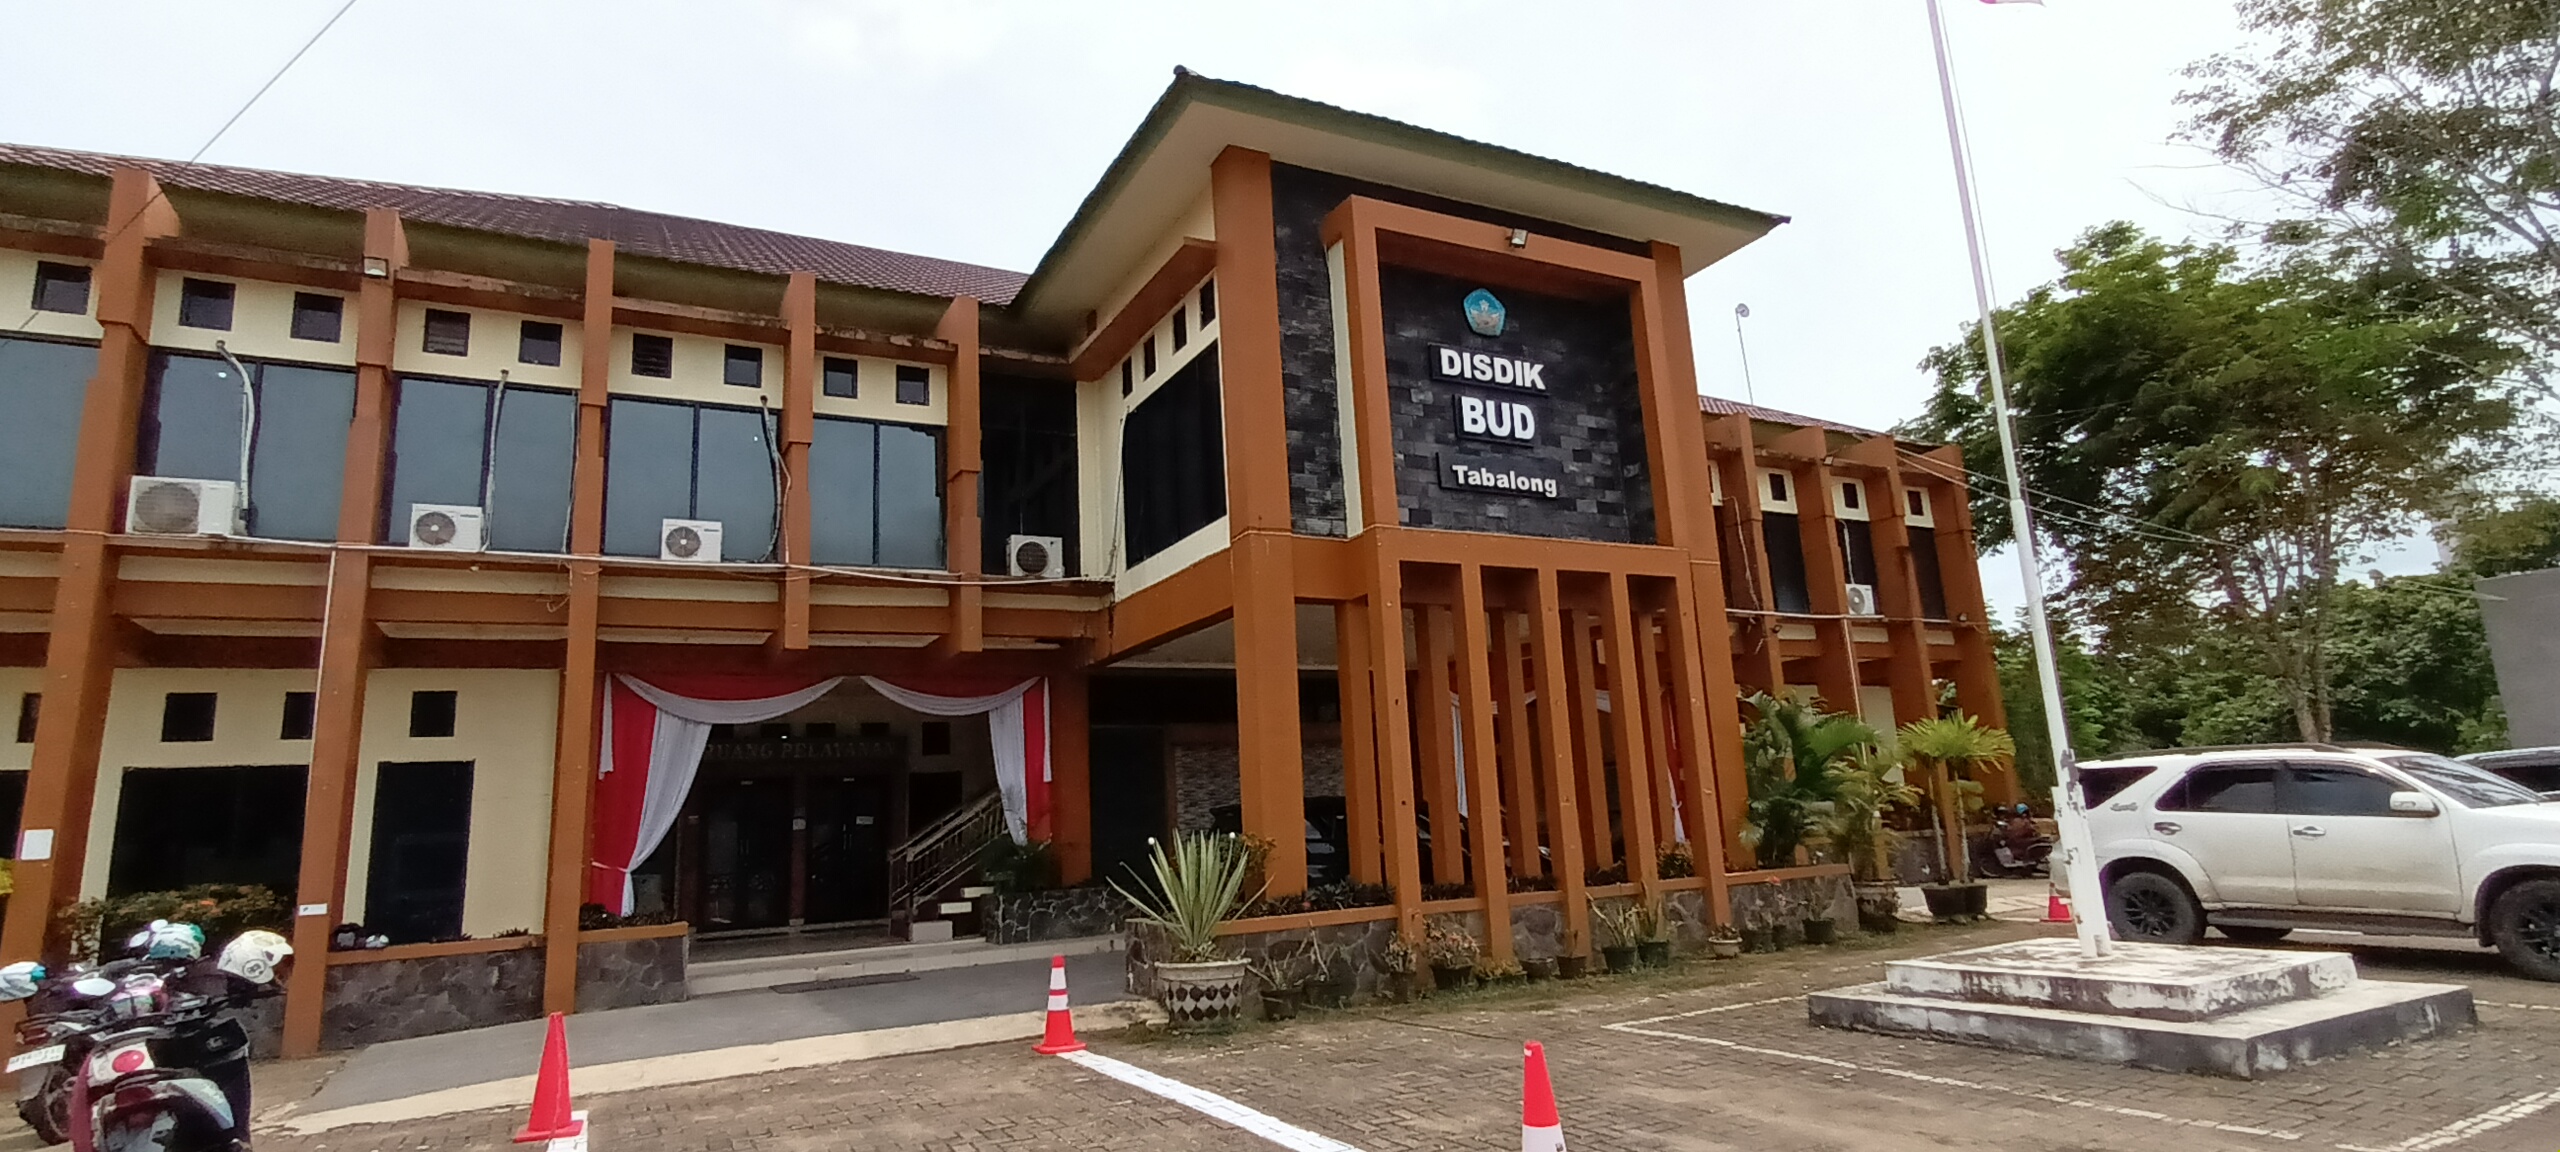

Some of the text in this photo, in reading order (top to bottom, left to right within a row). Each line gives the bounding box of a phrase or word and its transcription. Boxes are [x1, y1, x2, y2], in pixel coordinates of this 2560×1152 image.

[1440, 348, 1546, 390] DISDIK
[1461, 396, 1536, 440] BUD
[1452, 465, 1558, 498] Tabalong
